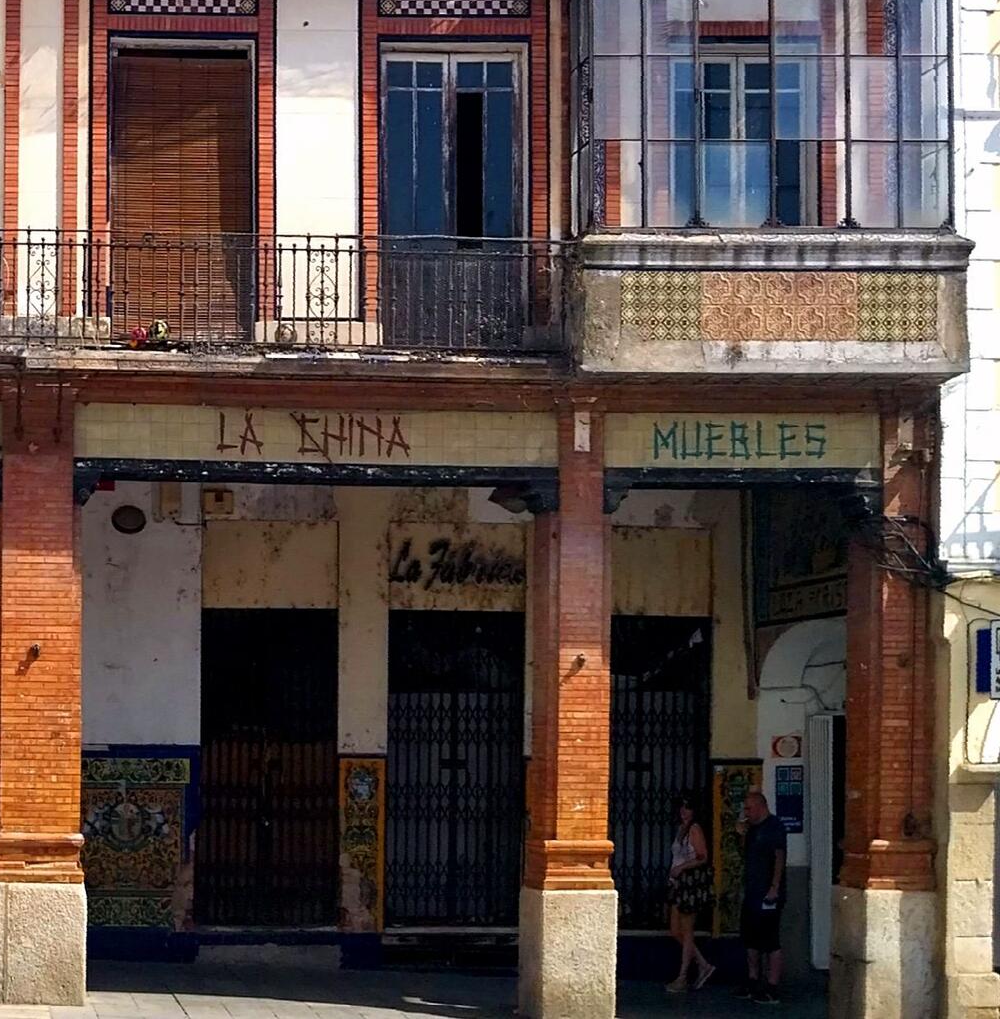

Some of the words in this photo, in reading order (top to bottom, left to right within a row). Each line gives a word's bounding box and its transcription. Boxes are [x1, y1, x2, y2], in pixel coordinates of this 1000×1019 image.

[216, 410, 264, 456] LA
[290, 411, 411, 464] CHINA
[653, 420, 827, 461] MUEBLES
